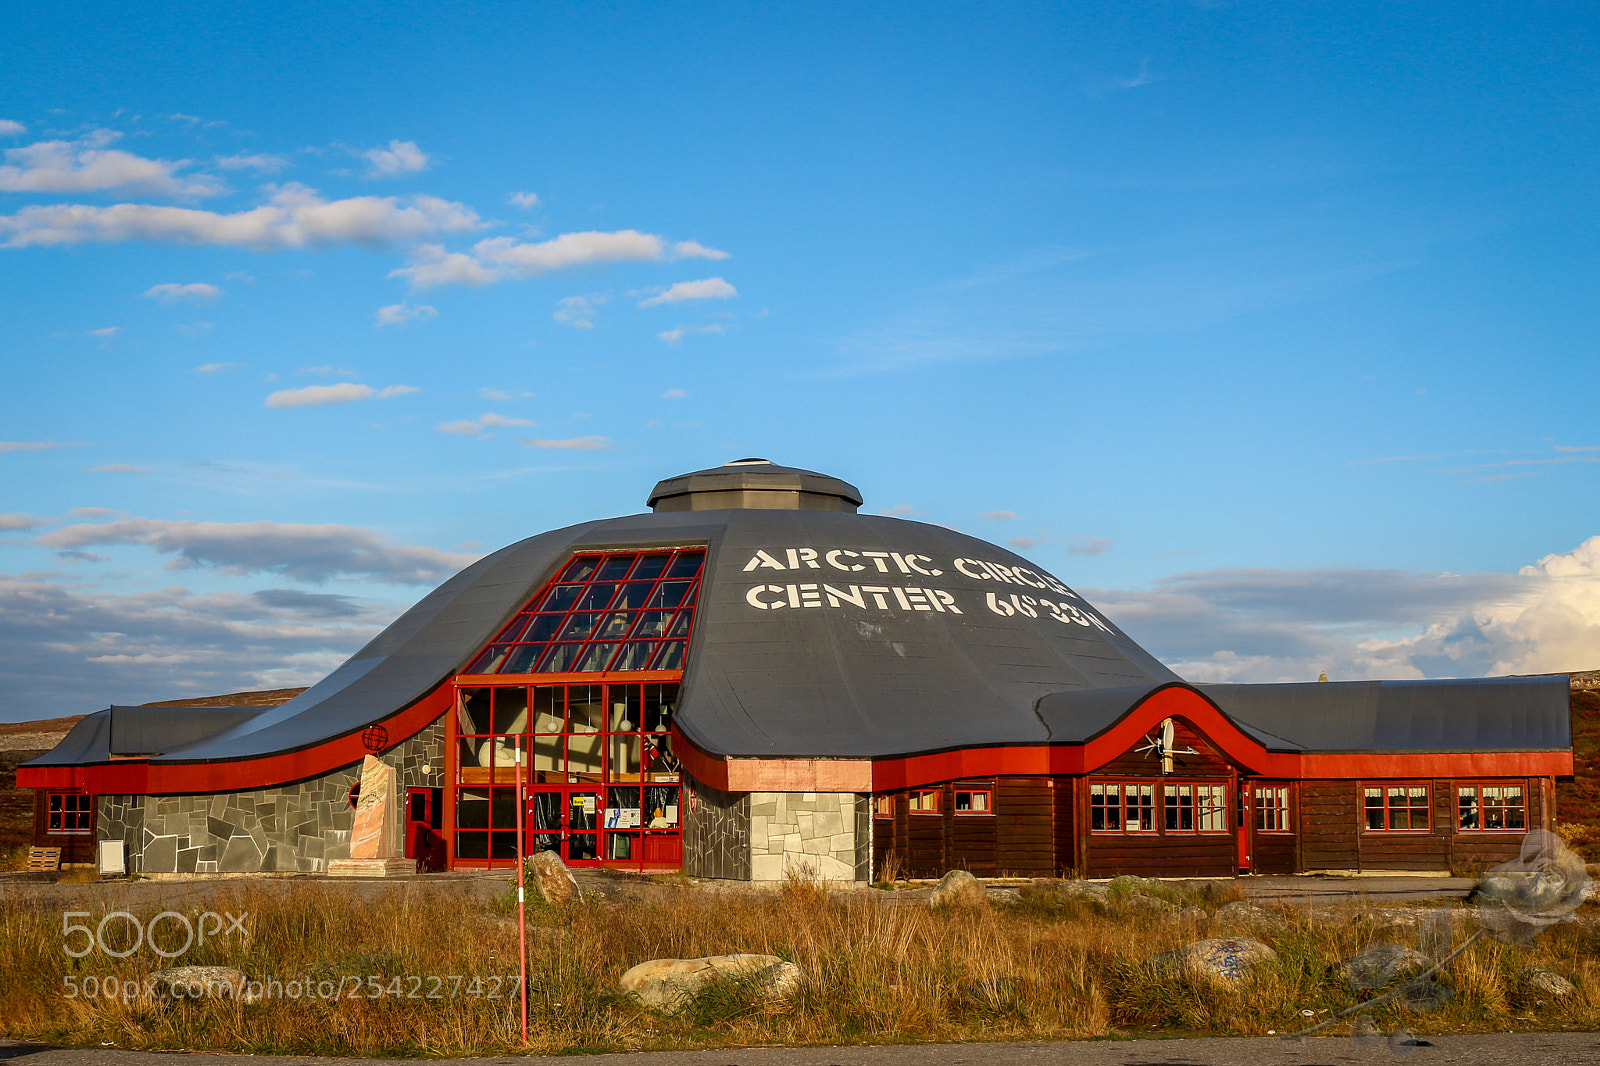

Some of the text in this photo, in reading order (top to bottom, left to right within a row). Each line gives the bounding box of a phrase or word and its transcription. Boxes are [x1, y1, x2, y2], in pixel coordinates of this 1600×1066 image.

[742, 547, 1078, 600] ARCTIC CIRCLE
[745, 583, 964, 615] CENTER
